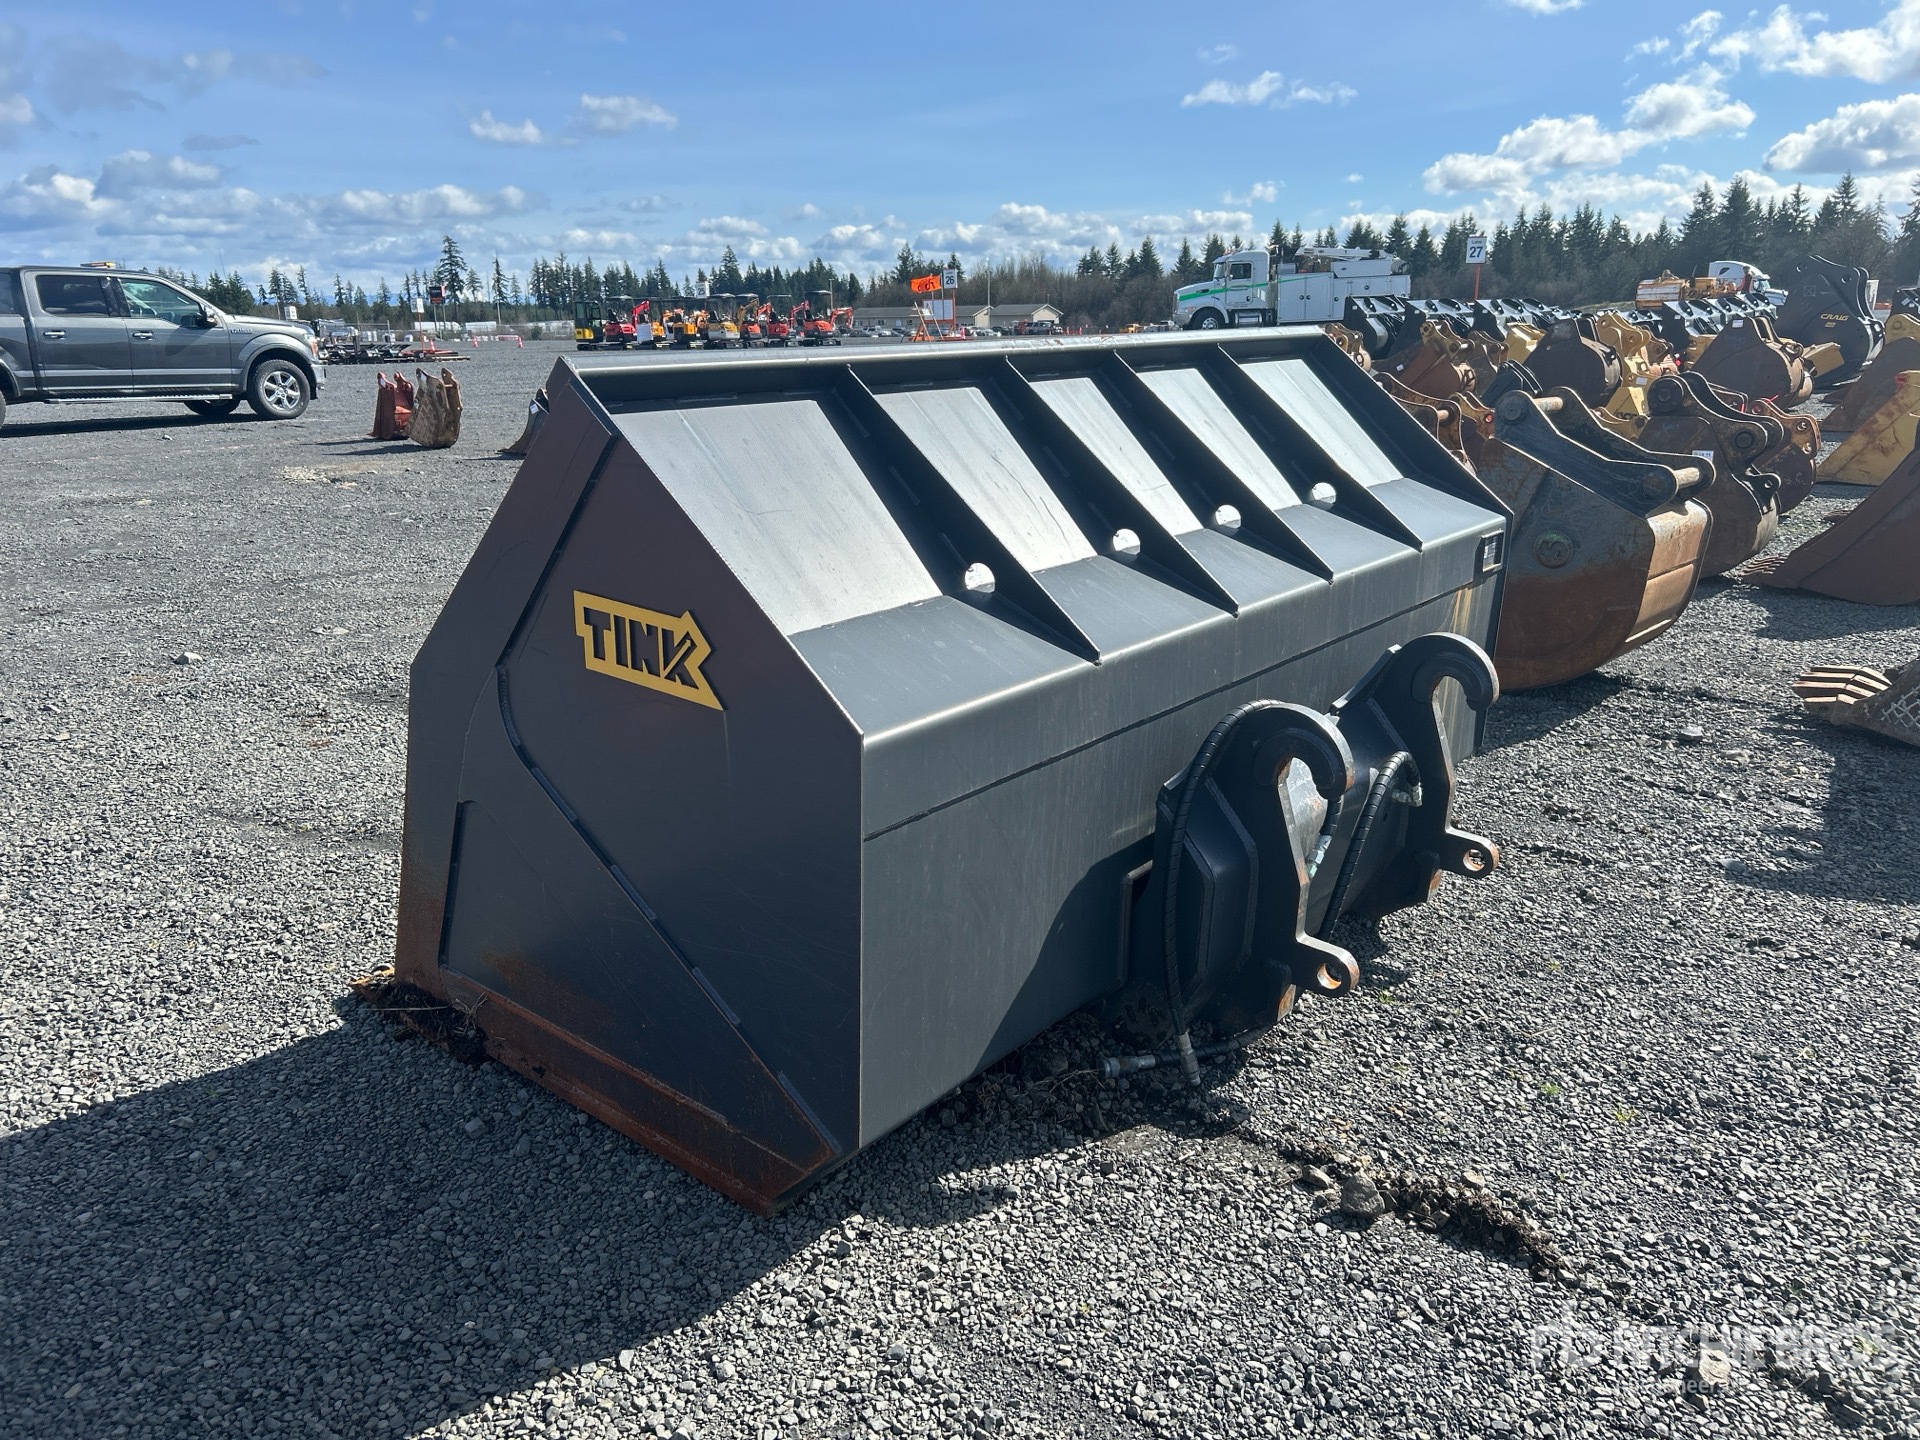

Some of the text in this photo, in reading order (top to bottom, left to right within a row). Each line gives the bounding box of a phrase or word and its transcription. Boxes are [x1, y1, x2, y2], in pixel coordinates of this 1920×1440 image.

[1469, 246, 1483, 258] 27
[945, 275, 955, 284] 26
[1820, 313, 1850, 321] CRAIG
[583, 606, 699, 690] TINK
